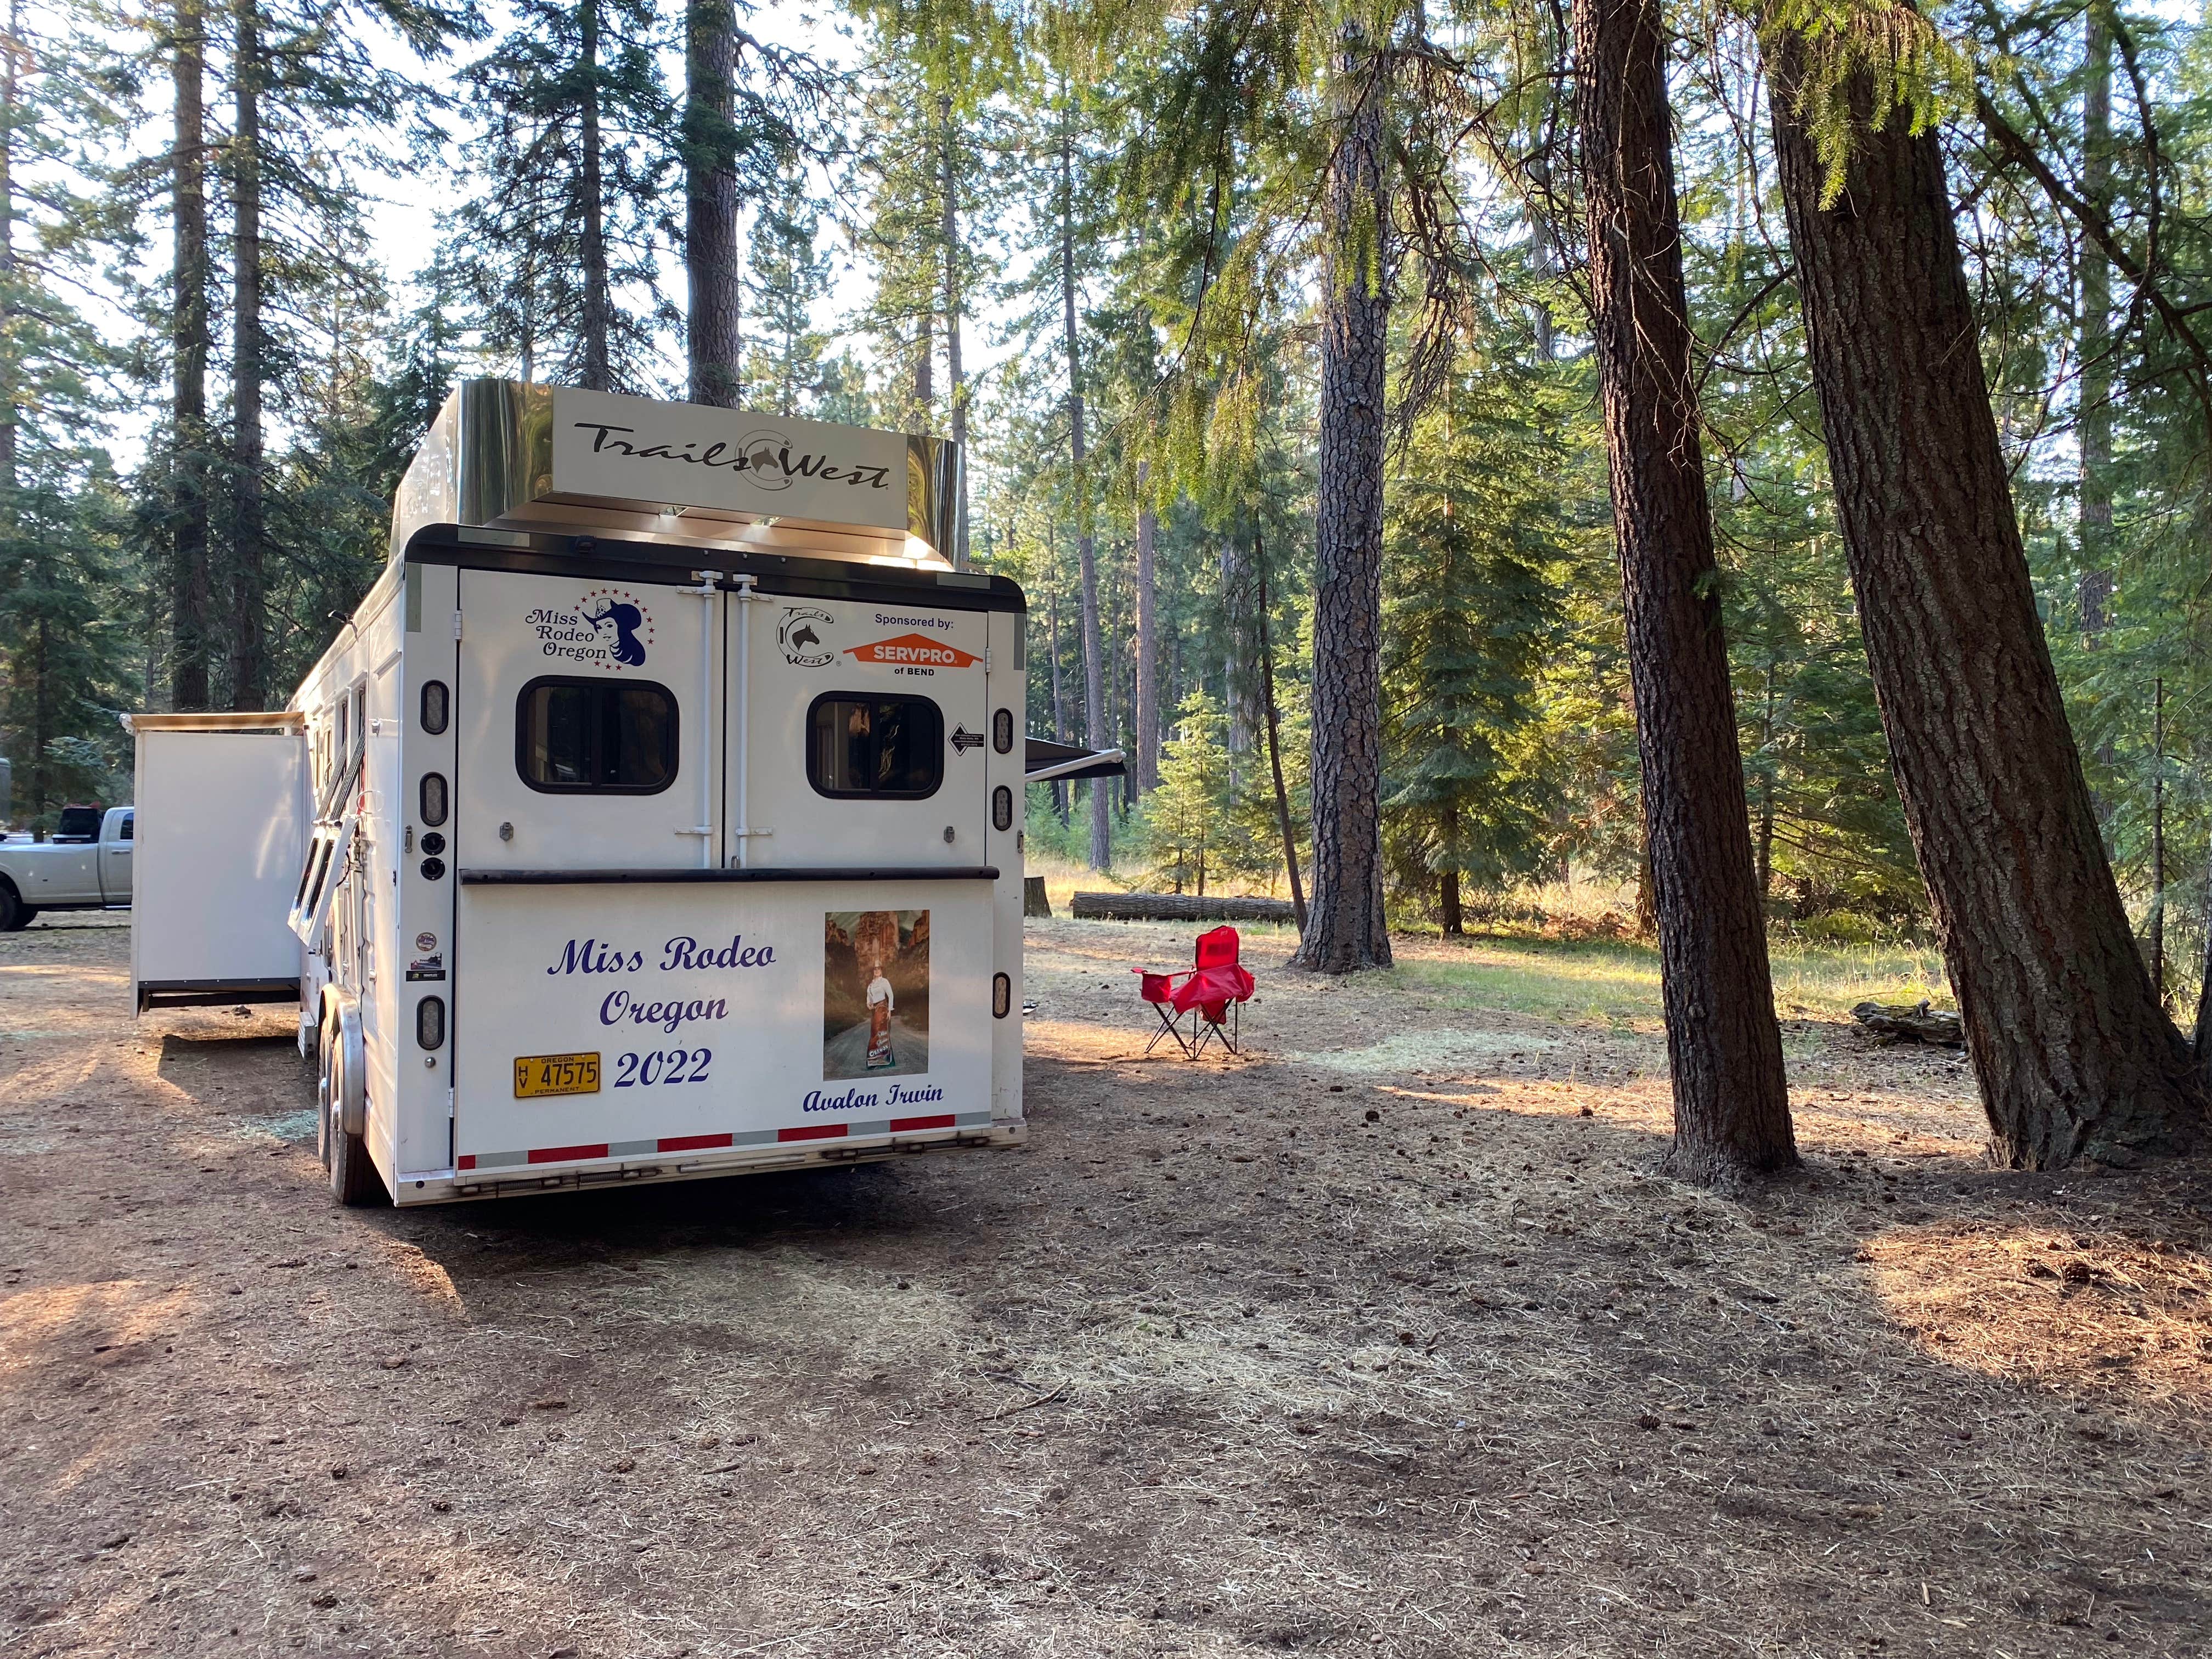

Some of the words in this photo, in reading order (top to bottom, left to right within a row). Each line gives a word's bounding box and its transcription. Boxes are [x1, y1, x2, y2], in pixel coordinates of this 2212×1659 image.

[574, 423, 751, 471] Trails
[778, 448, 889, 488] West
[525, 609, 578, 625] Miss
[783, 607, 823, 617] Trails
[875, 613, 934, 627] Sponsored
[938, 618, 953, 630] by:
[536, 625, 594, 642] Rodeo
[543, 642, 606, 661] Oregon
[786, 654, 822, 664] West
[873, 645, 955, 664] SERVPRO
[547, 939, 643, 975] Miss
[659, 935, 776, 970] Rodeo
[600, 990, 729, 1034] Oregon
[541, 1062, 597, 1086] 47575
[614, 1048, 712, 1087] 2022
[803, 1088, 879, 1112] Avalon
[885, 1084, 944, 1105] Irwin
